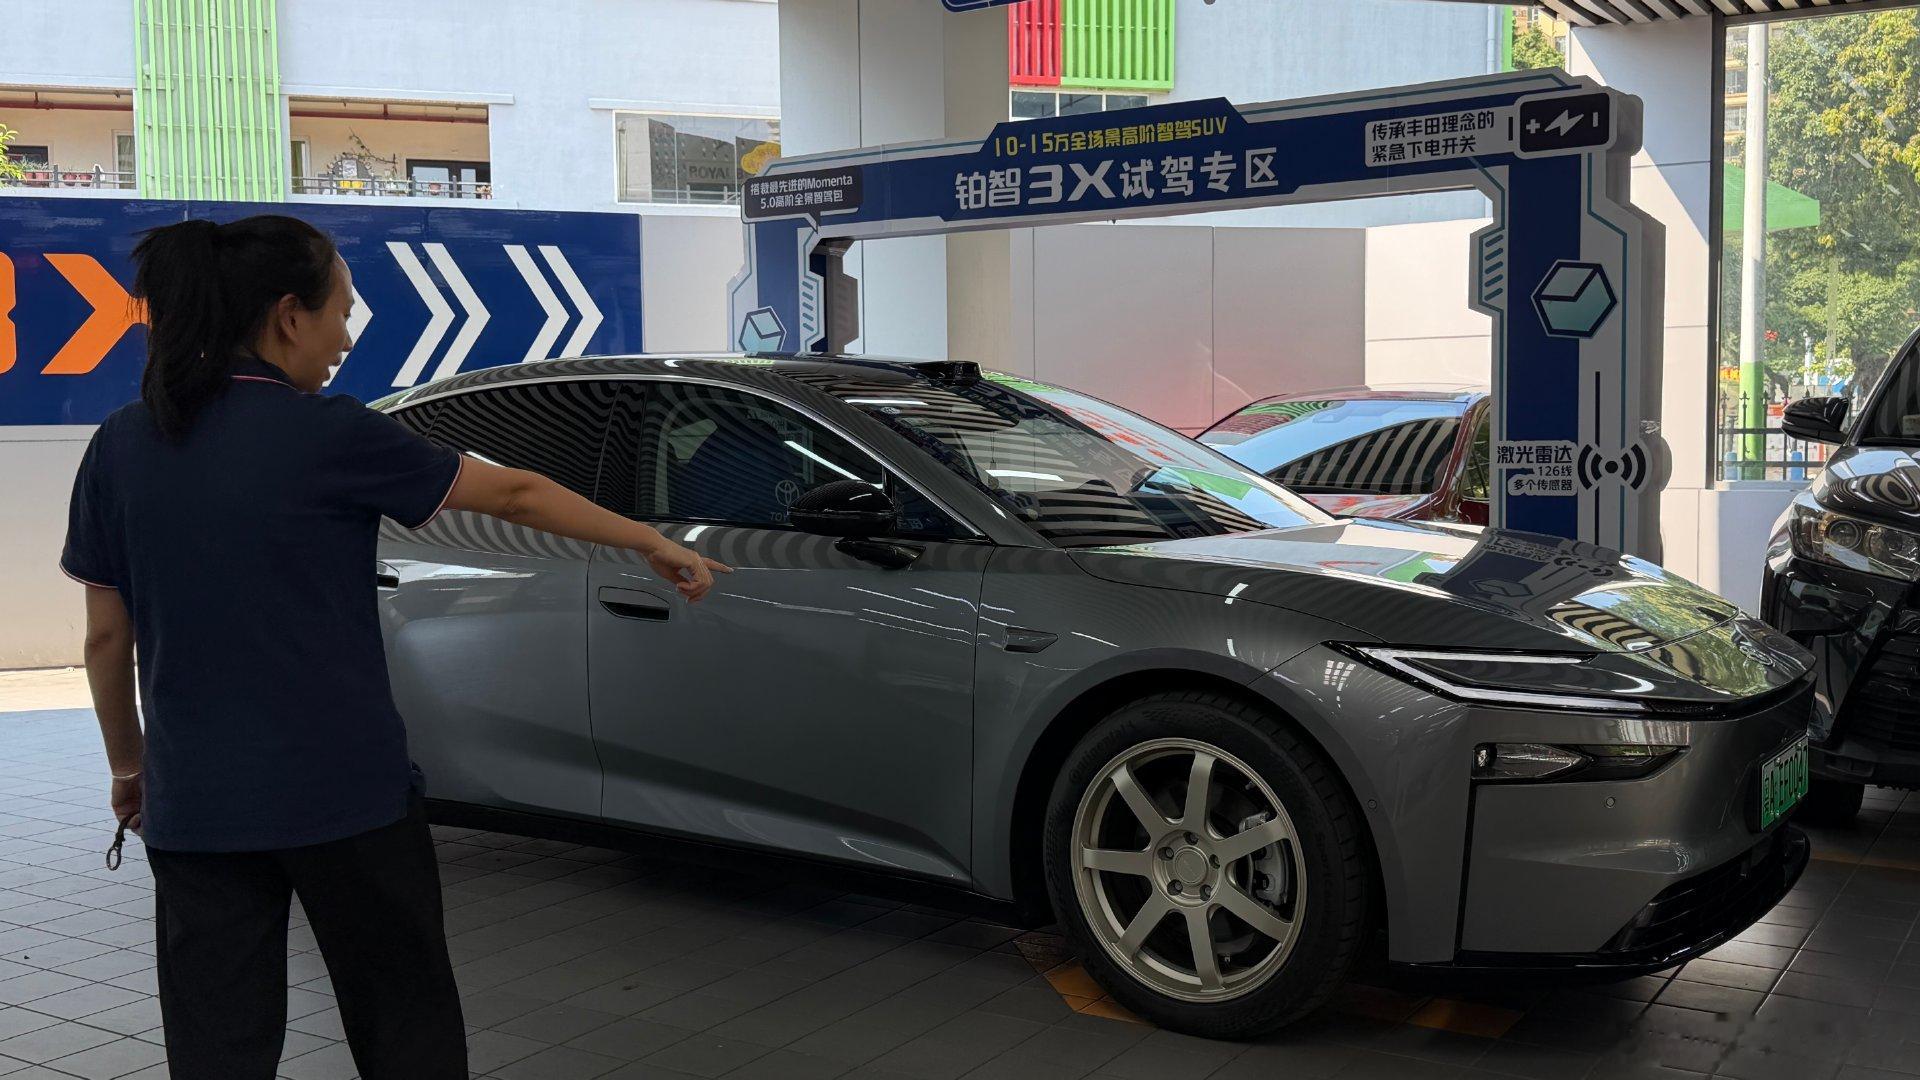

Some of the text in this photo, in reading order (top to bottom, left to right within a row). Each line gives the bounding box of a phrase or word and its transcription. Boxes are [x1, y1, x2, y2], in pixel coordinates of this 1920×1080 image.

[1372, 110, 1495, 141] 传承丰田理念的
[1372, 135, 1476, 163] 紧急下电开关
[750, 175, 853, 196] 搭载最先进的Momenta
[955, 147, 1279, 210] 铂智3X试驾专区
[1497, 445, 1572, 464] 激光雷达
[1538, 465, 1572, 477] 126线
[1513, 479, 1572, 491] 多个传感器
